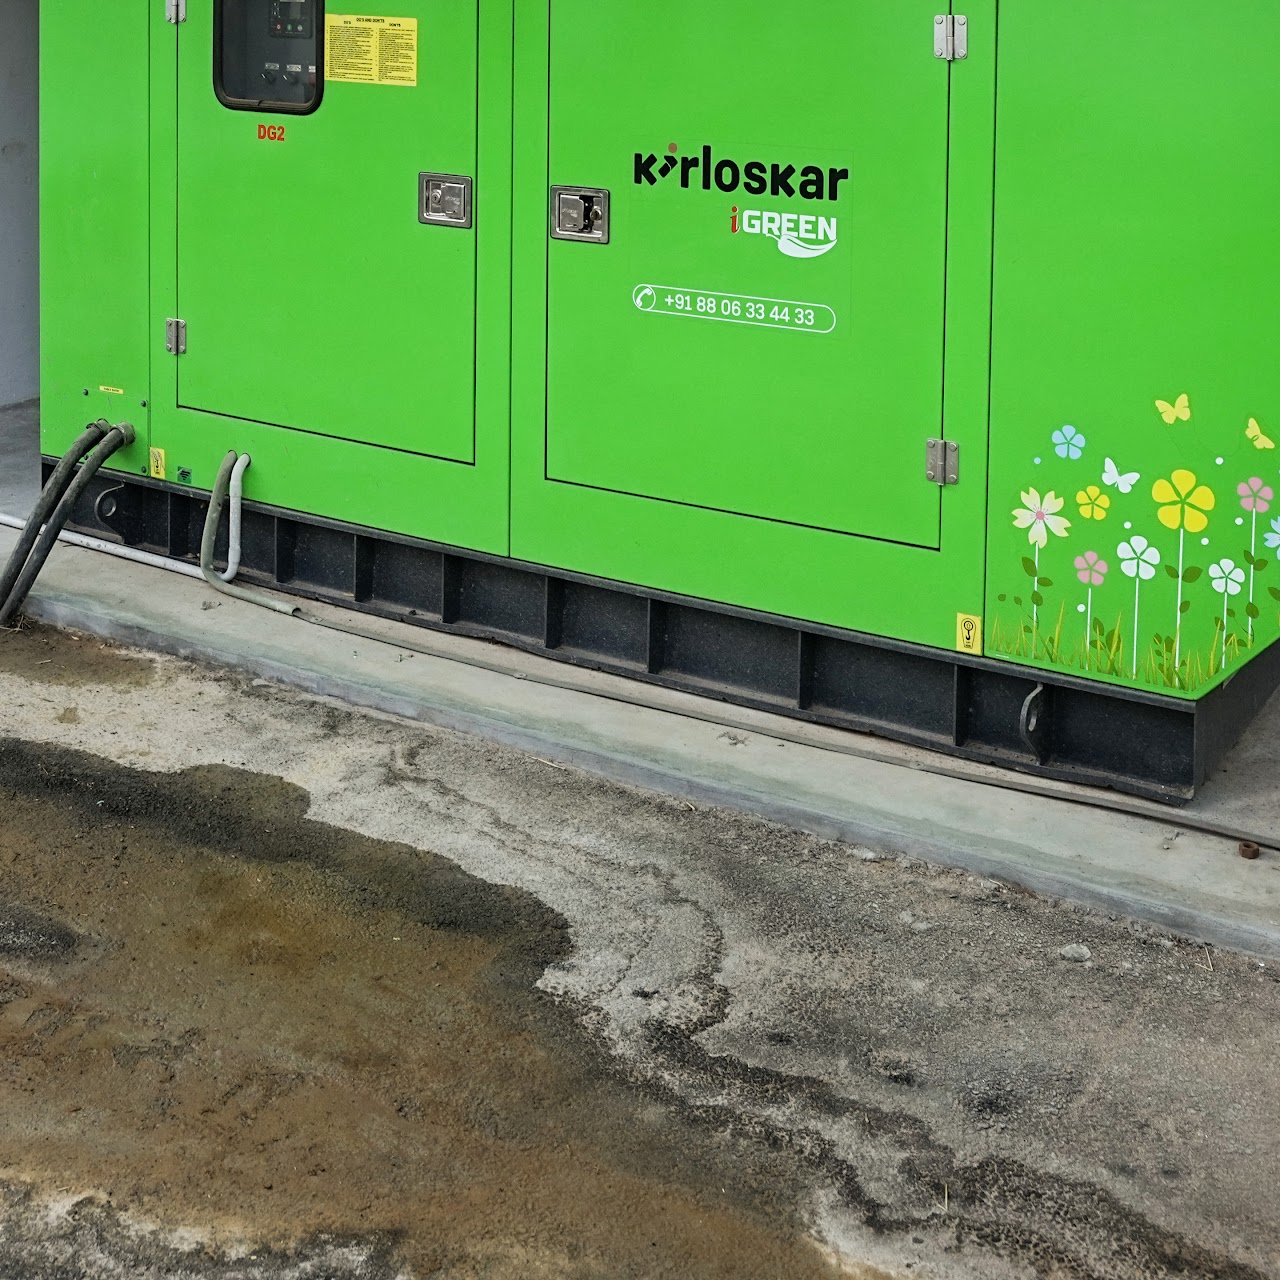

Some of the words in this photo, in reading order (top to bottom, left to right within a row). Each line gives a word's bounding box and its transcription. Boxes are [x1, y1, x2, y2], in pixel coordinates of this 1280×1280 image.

[257, 124, 285, 142] DG2
[664, 293, 693, 311] +91
[696, 296, 717, 314] 88
[721, 299, 741, 317] 06
[745, 302, 765, 320] 33
[769, 305, 790, 323] 44
[794, 308, 815, 325] 33
